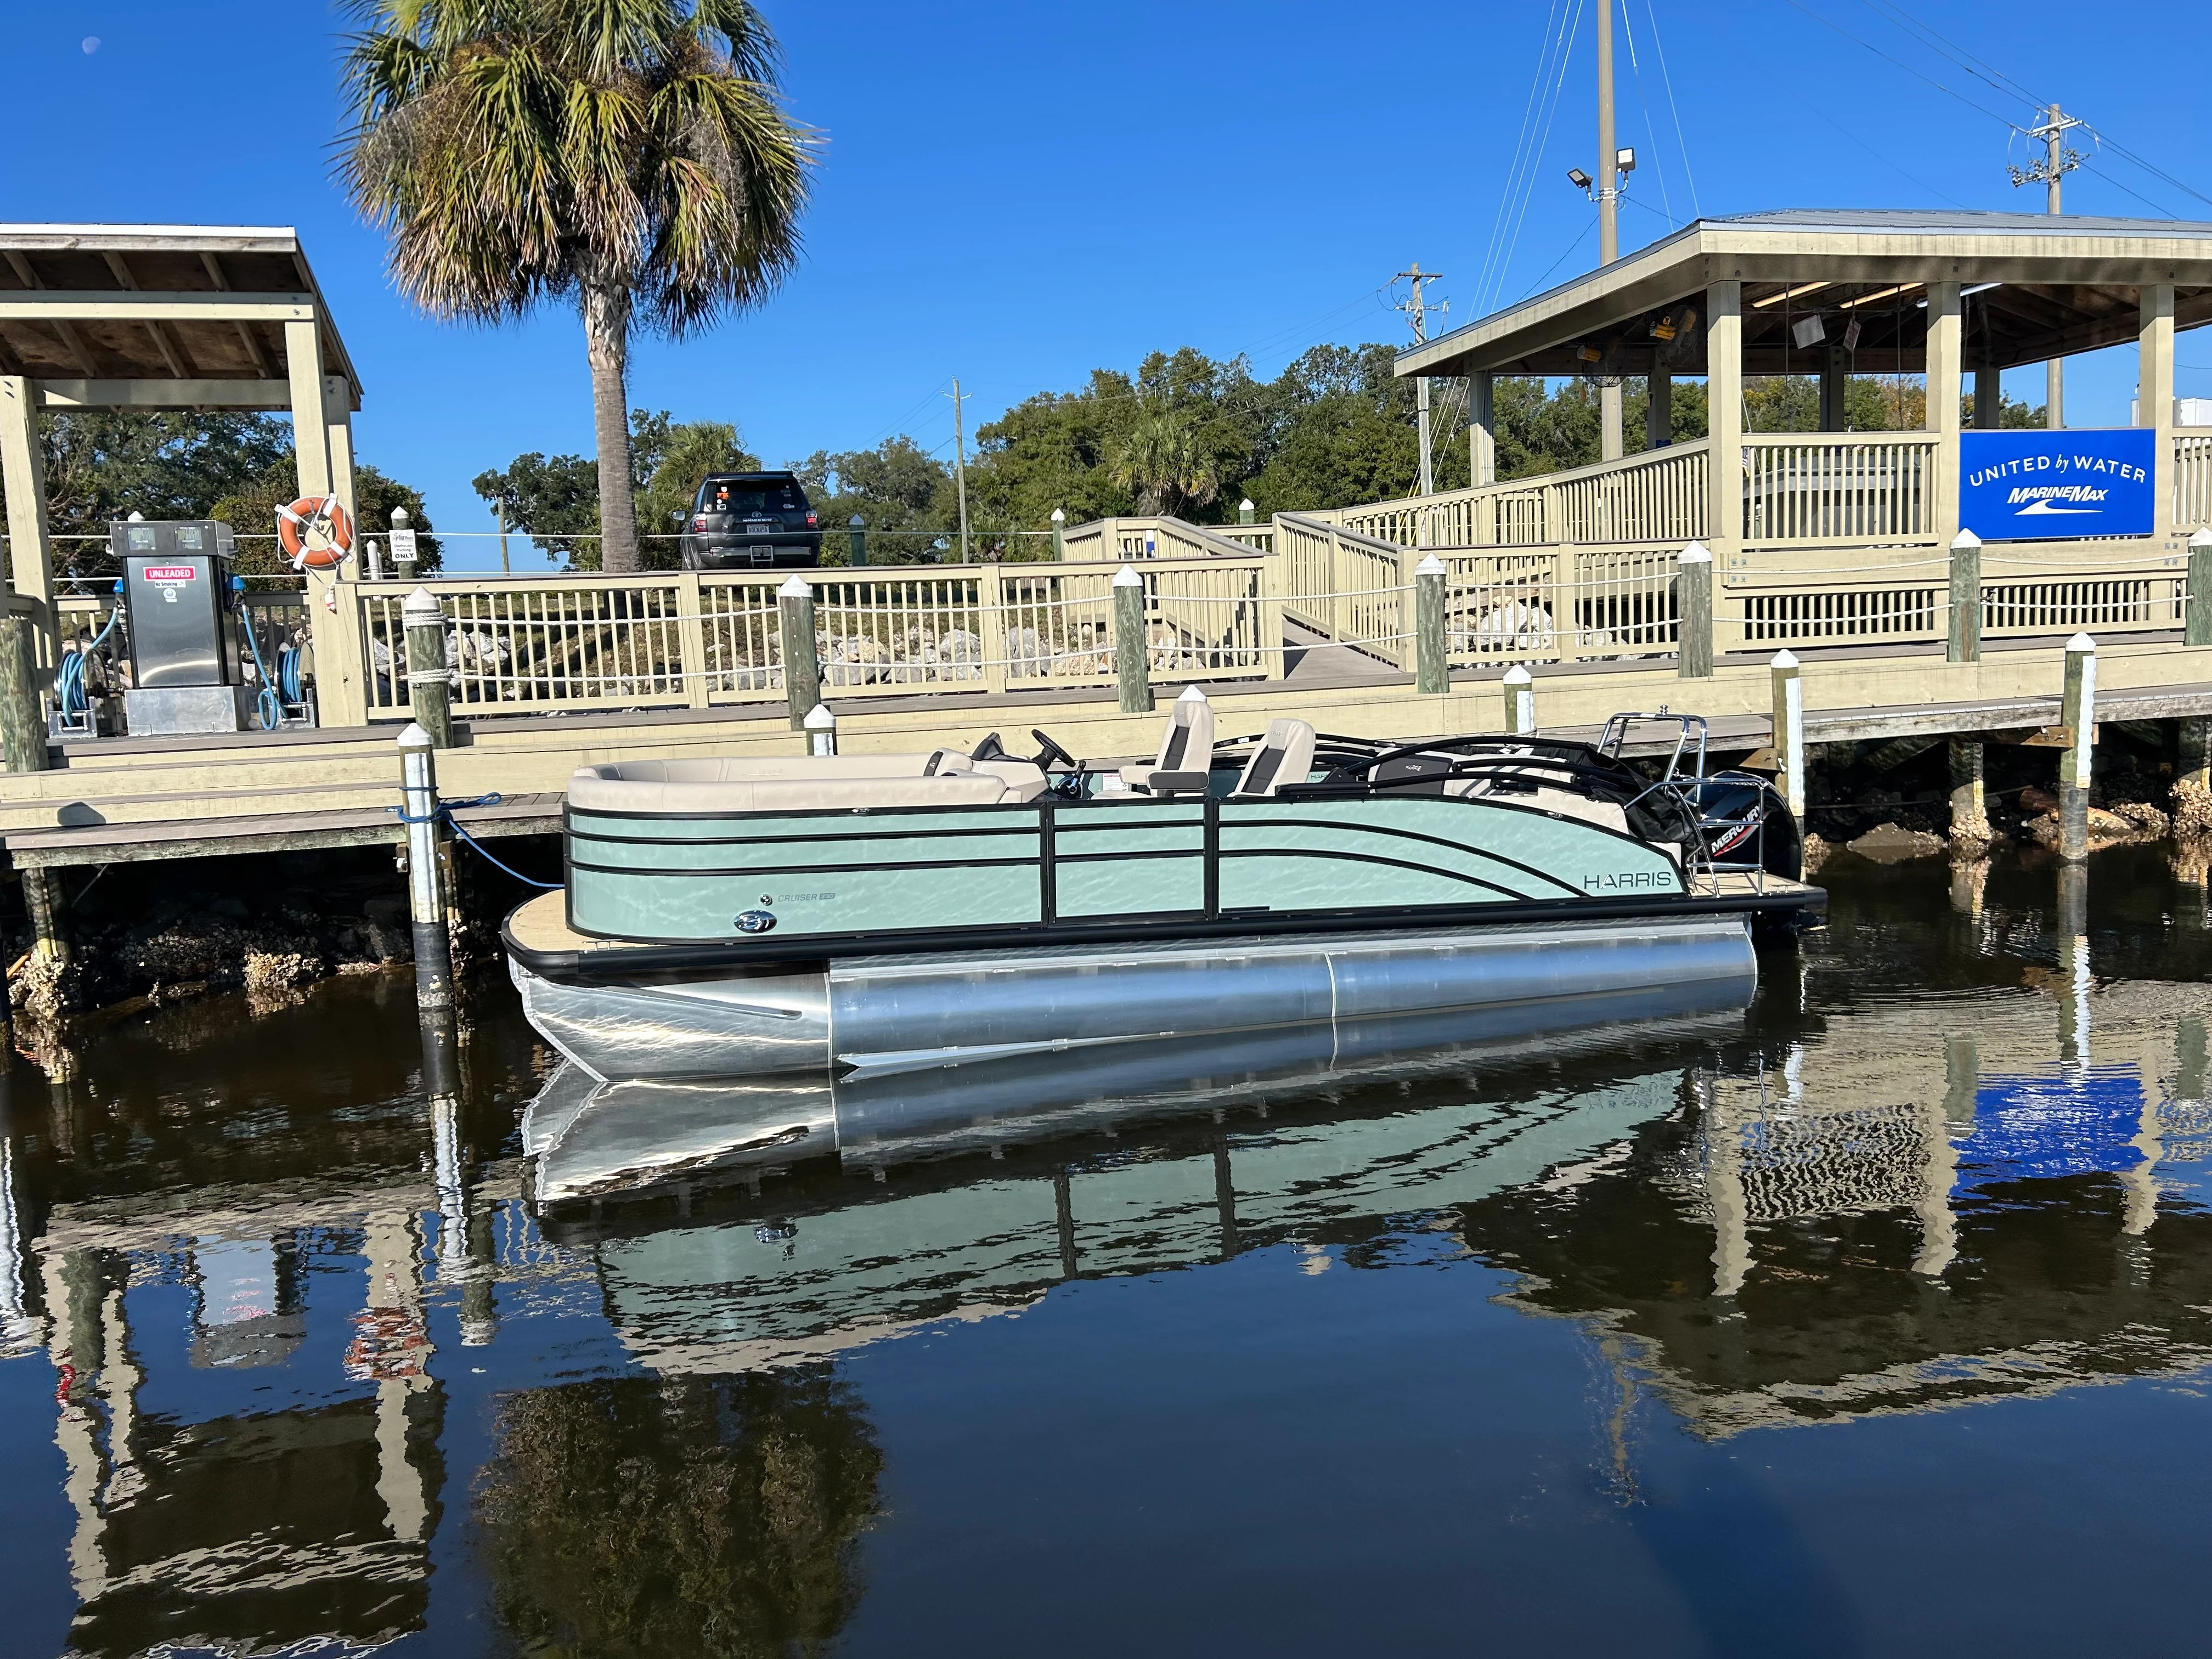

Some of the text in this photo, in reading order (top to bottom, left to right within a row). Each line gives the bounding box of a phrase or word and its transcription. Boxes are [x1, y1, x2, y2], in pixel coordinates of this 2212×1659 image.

[1970, 454, 2146, 487] UNITED by WATER
[149, 569, 191, 578] UNLEADED
[1584, 871, 1672, 889] HARRIS
[778, 894, 817, 902] CRUISER
